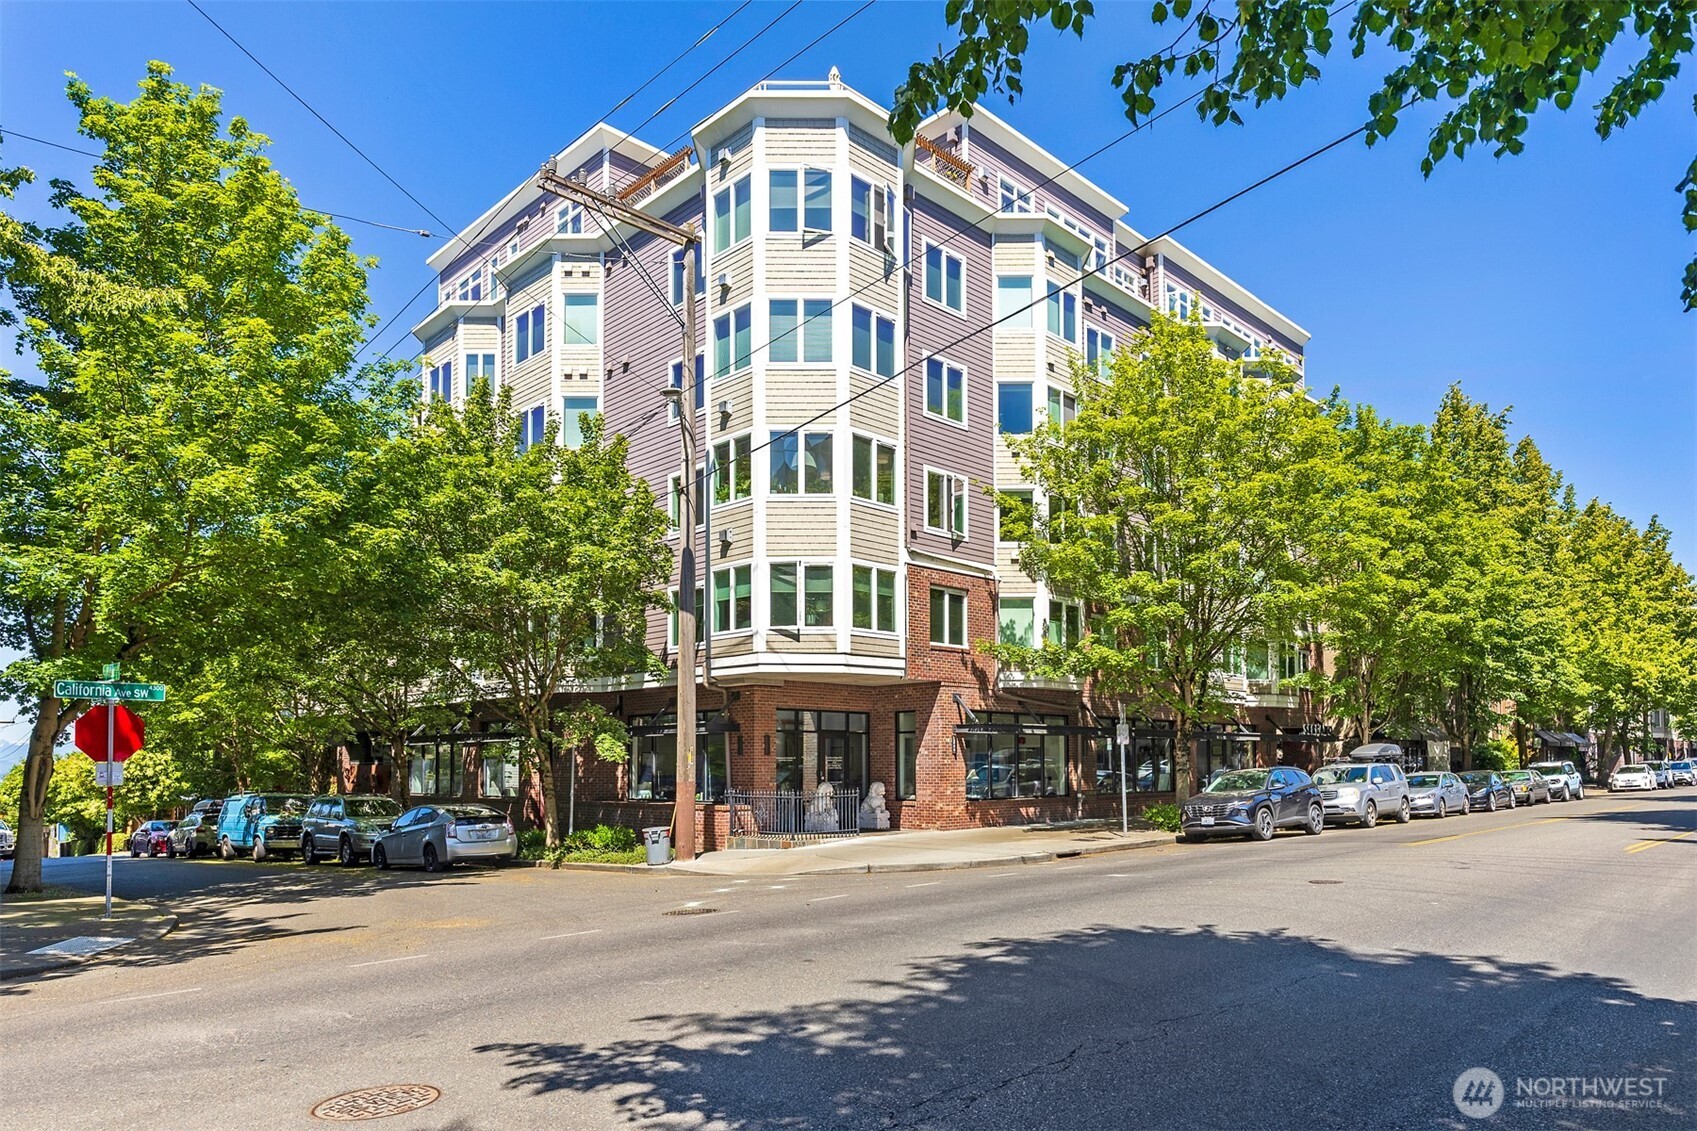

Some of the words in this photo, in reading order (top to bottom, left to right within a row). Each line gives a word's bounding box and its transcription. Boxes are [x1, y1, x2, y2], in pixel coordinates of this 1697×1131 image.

[56, 682, 112, 697] California
[114, 689, 131, 698] Ave
[133, 689, 149, 698] SW
